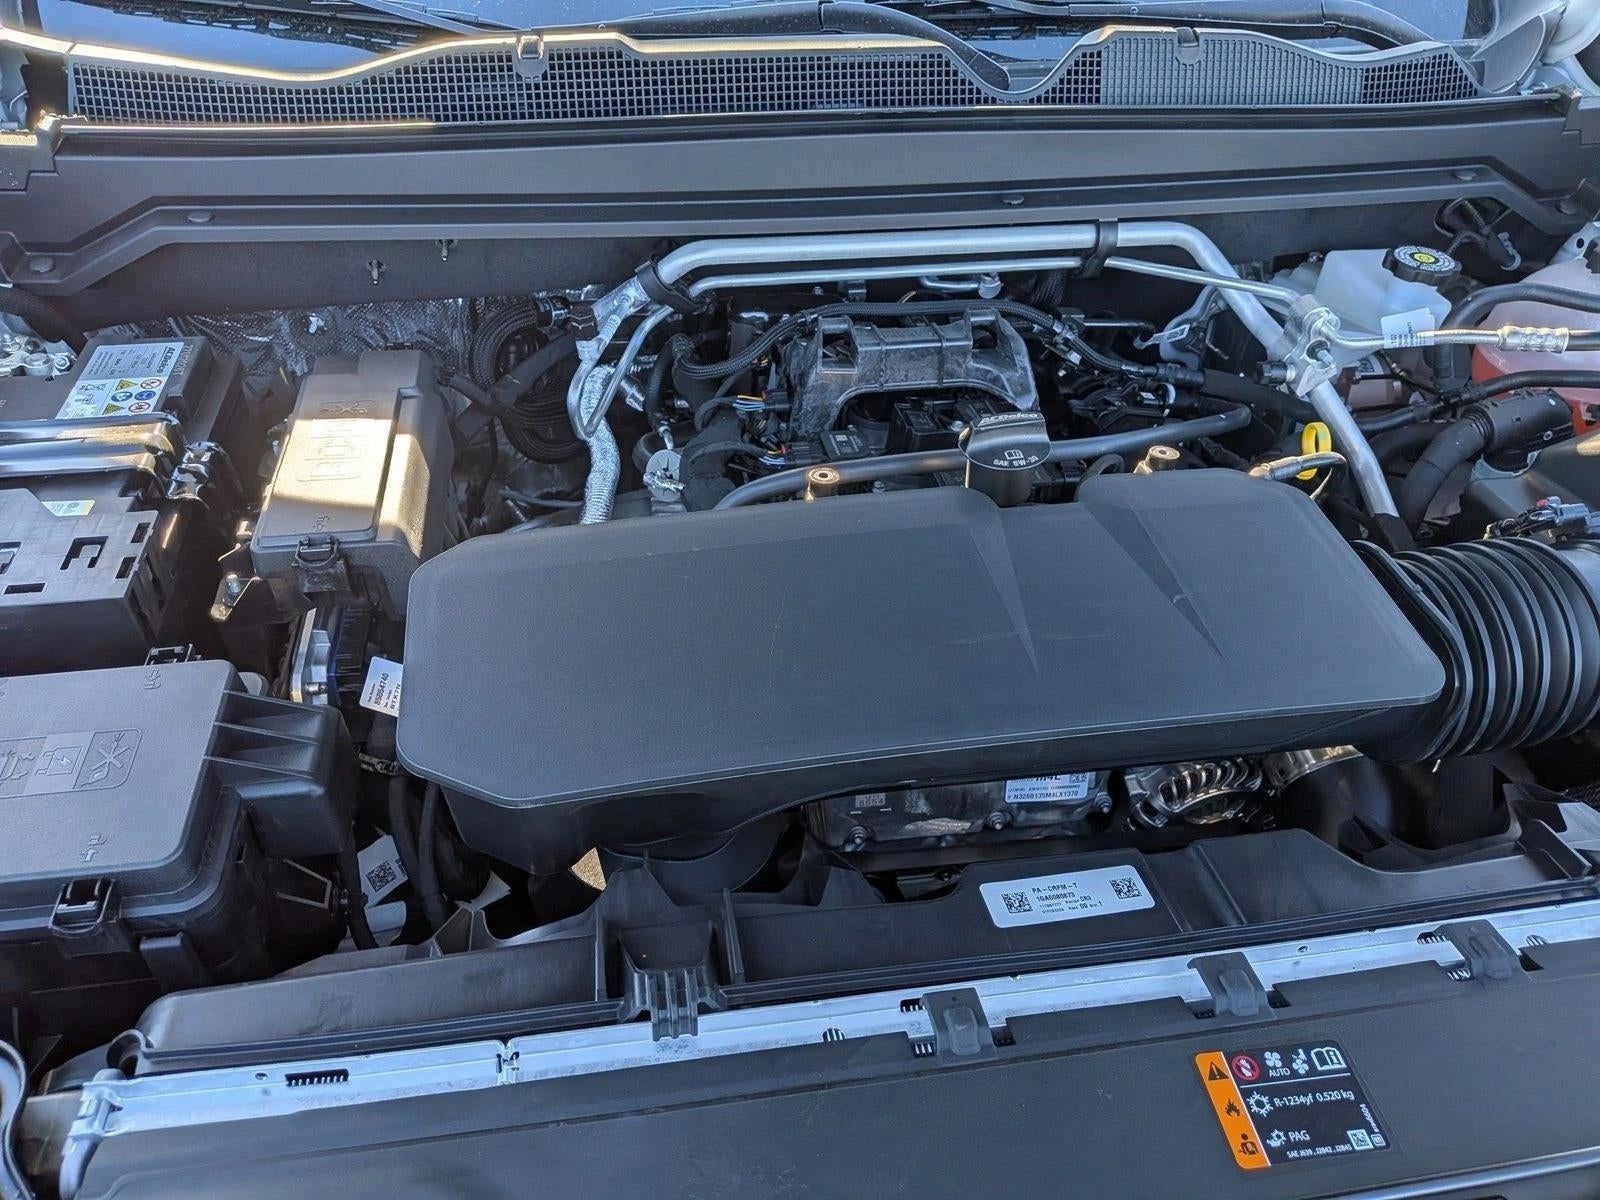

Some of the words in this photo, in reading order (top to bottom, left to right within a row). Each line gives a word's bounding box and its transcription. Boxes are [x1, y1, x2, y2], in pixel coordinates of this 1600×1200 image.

[157, 346, 175, 373] ACDelco
[993, 458, 1010, 467] SAE
[1269, 1067, 1291, 1078] AUTO
[1273, 1094, 1314, 1108] R-1234yf
[1316, 1091, 1341, 1103] 0.520
[1341, 1089, 1355, 1102] kg
[1288, 1130, 1310, 1142] PAG
[1286, 1150, 1299, 1158] SAE
